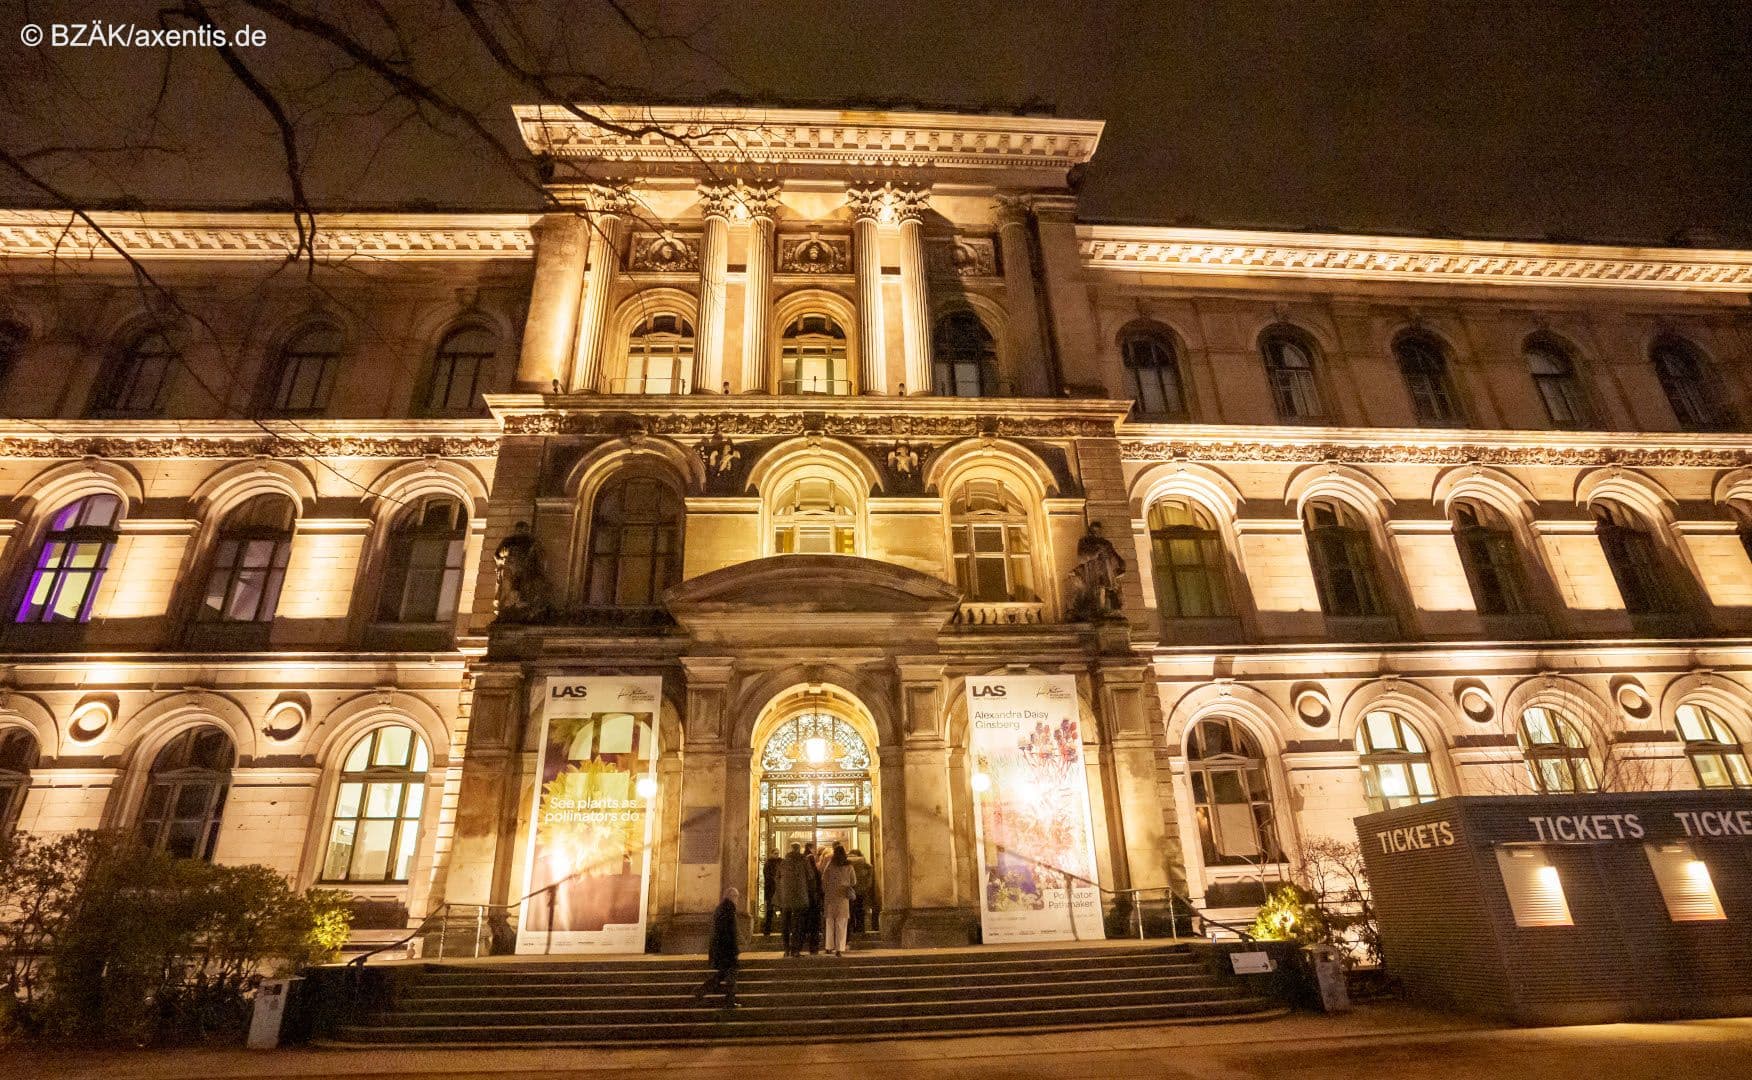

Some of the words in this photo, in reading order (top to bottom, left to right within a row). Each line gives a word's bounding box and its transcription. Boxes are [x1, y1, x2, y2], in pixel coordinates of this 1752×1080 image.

[551, 686, 587, 698] LAS
[972, 685, 1007, 697] LAS
[975, 710, 1022, 719] Alexandra
[1024, 710, 1048, 720] Daisy
[975, 720, 1020, 731] Ginsberg
[550, 797, 575, 809] See
[577, 796, 619, 811] plants
[621, 800, 637, 809] as
[544, 810, 618, 824] pollinators
[620, 810, 640, 822] do
[1674, 811, 1752, 836] TICKE
[1529, 814, 1645, 841] TICKETS
[1377, 821, 1454, 854] TICKETS
